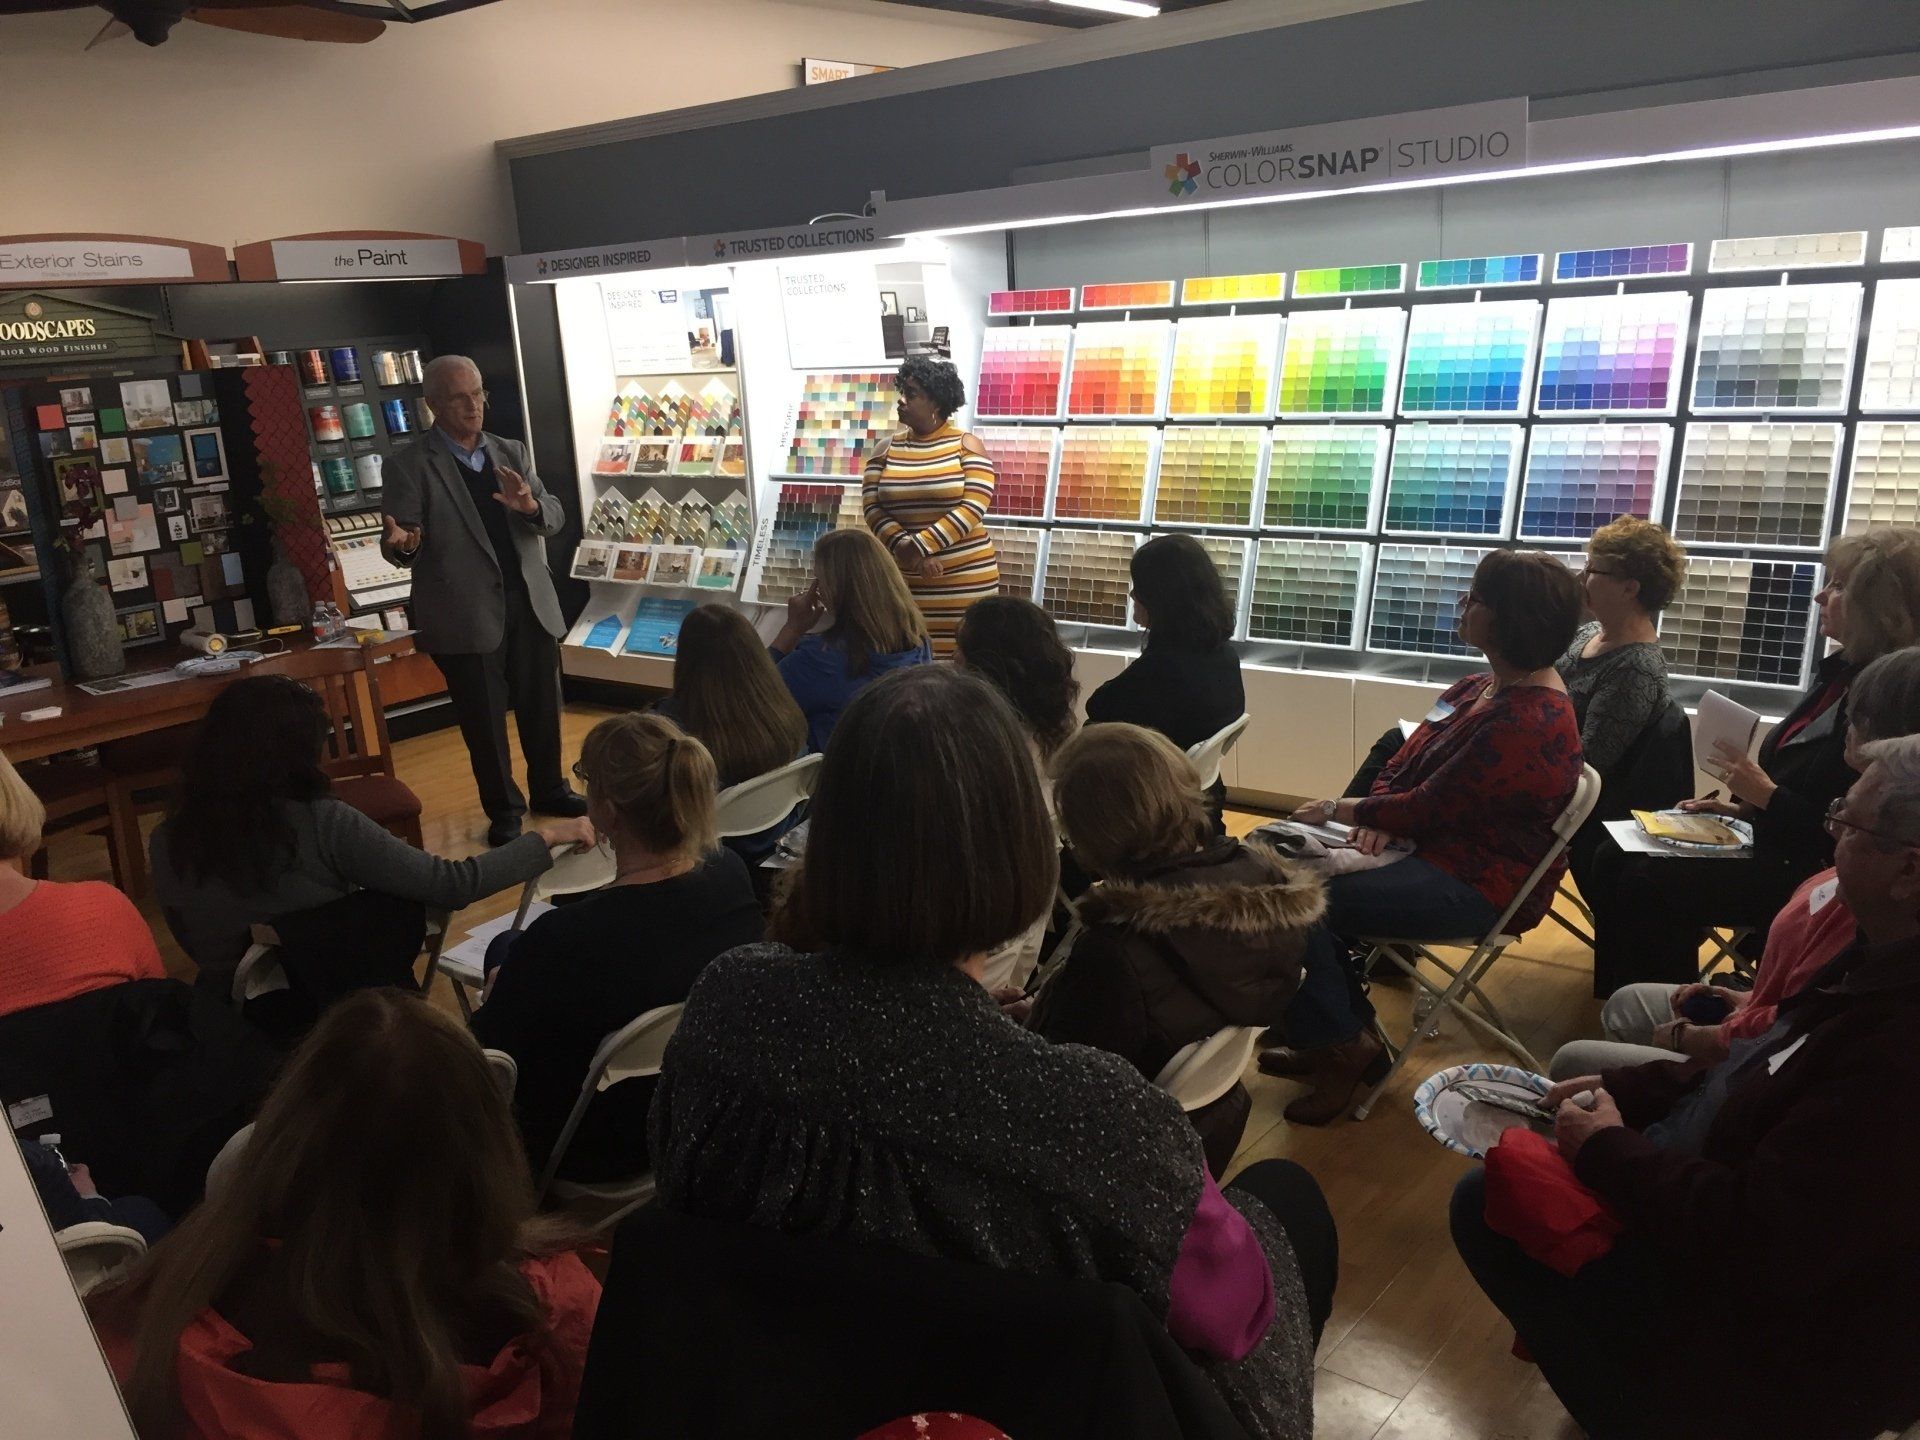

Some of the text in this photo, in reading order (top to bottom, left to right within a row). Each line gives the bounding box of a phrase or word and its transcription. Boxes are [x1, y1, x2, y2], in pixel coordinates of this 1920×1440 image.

[811, 65, 849, 81] SMART
[1397, 131, 1509, 168] STUDIO
[729, 228, 874, 255] TRUSTED COLLECTIONS
[0, 252, 143, 270] Exterior Stains
[334, 249, 408, 267] the Paint
[551, 250, 651, 271] DESIGNER INSPIRED
[785, 274, 825, 284] TRUSTED
[787, 283, 846, 296] COLLECTIONS
[752, 518, 769, 567] TIMELESS
